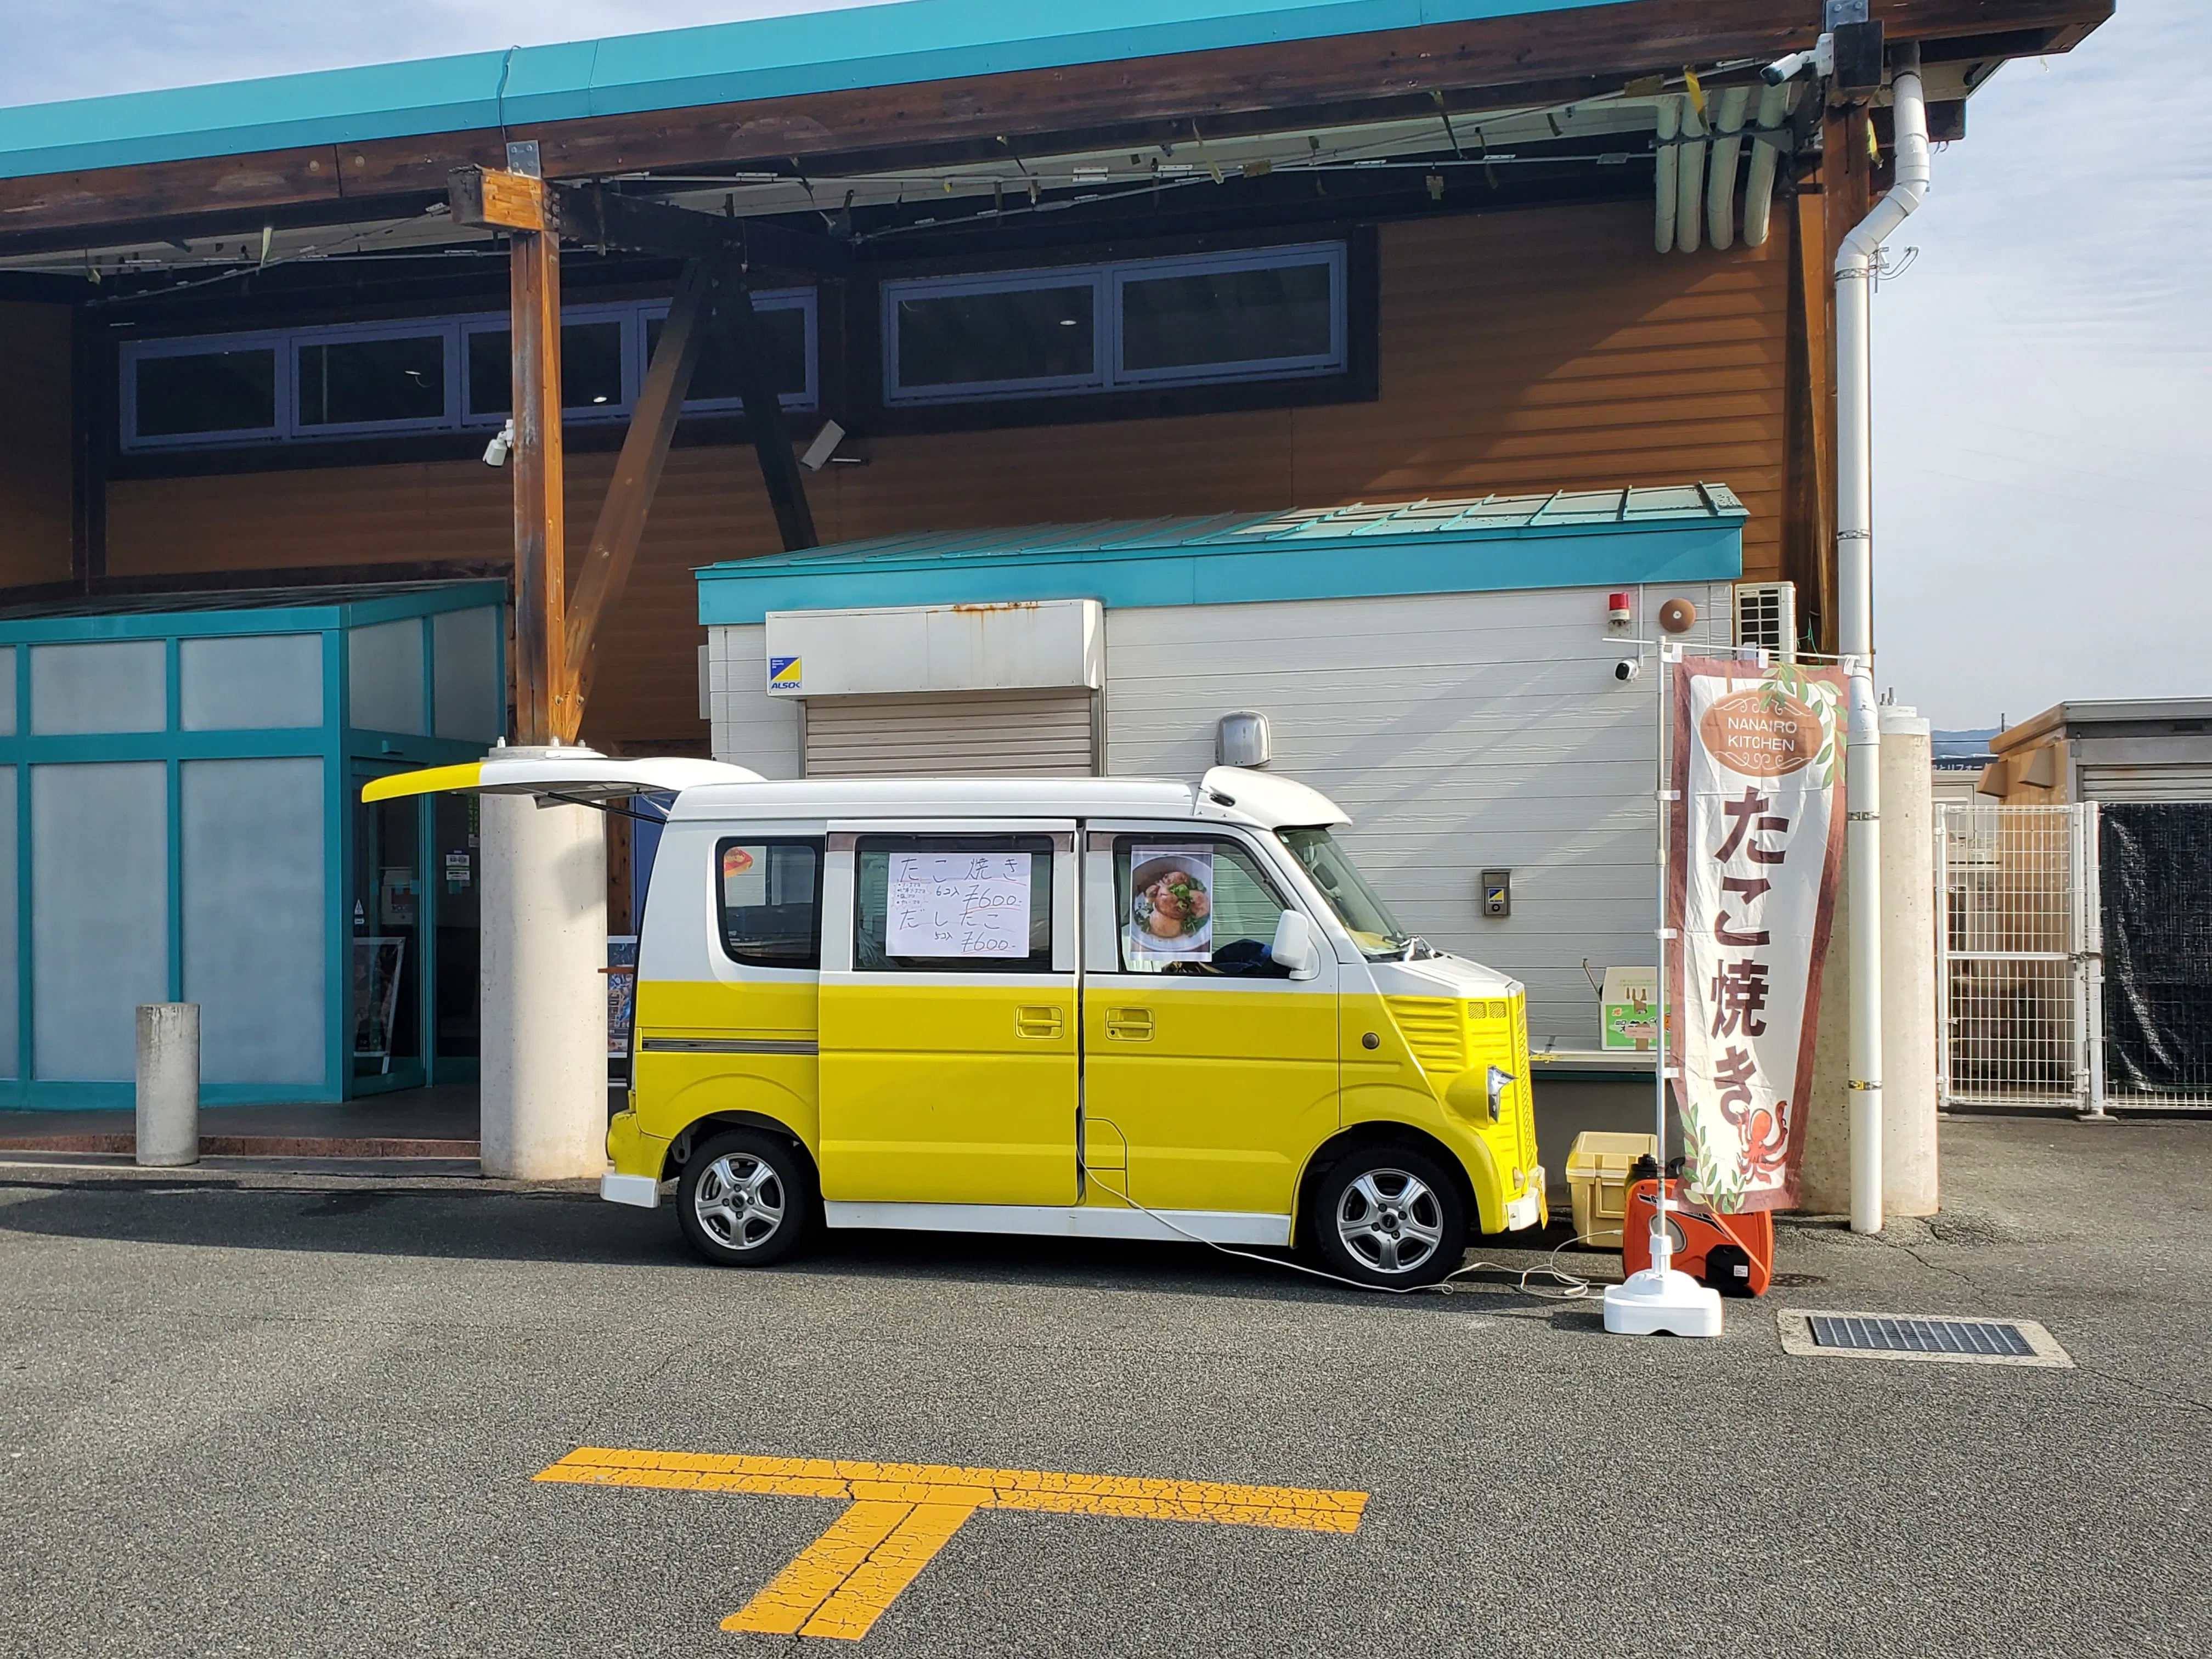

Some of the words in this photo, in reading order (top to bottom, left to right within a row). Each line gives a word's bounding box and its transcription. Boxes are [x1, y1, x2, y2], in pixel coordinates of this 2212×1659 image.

[1728, 717, 1797, 733] NANAIRO
[1728, 735, 1794, 752] KITCHEN
[900, 857, 1017, 883] たこ焼き
[900, 909, 1000, 930] だしたこ
[1711, 785, 1789, 1127] たこ焼き
